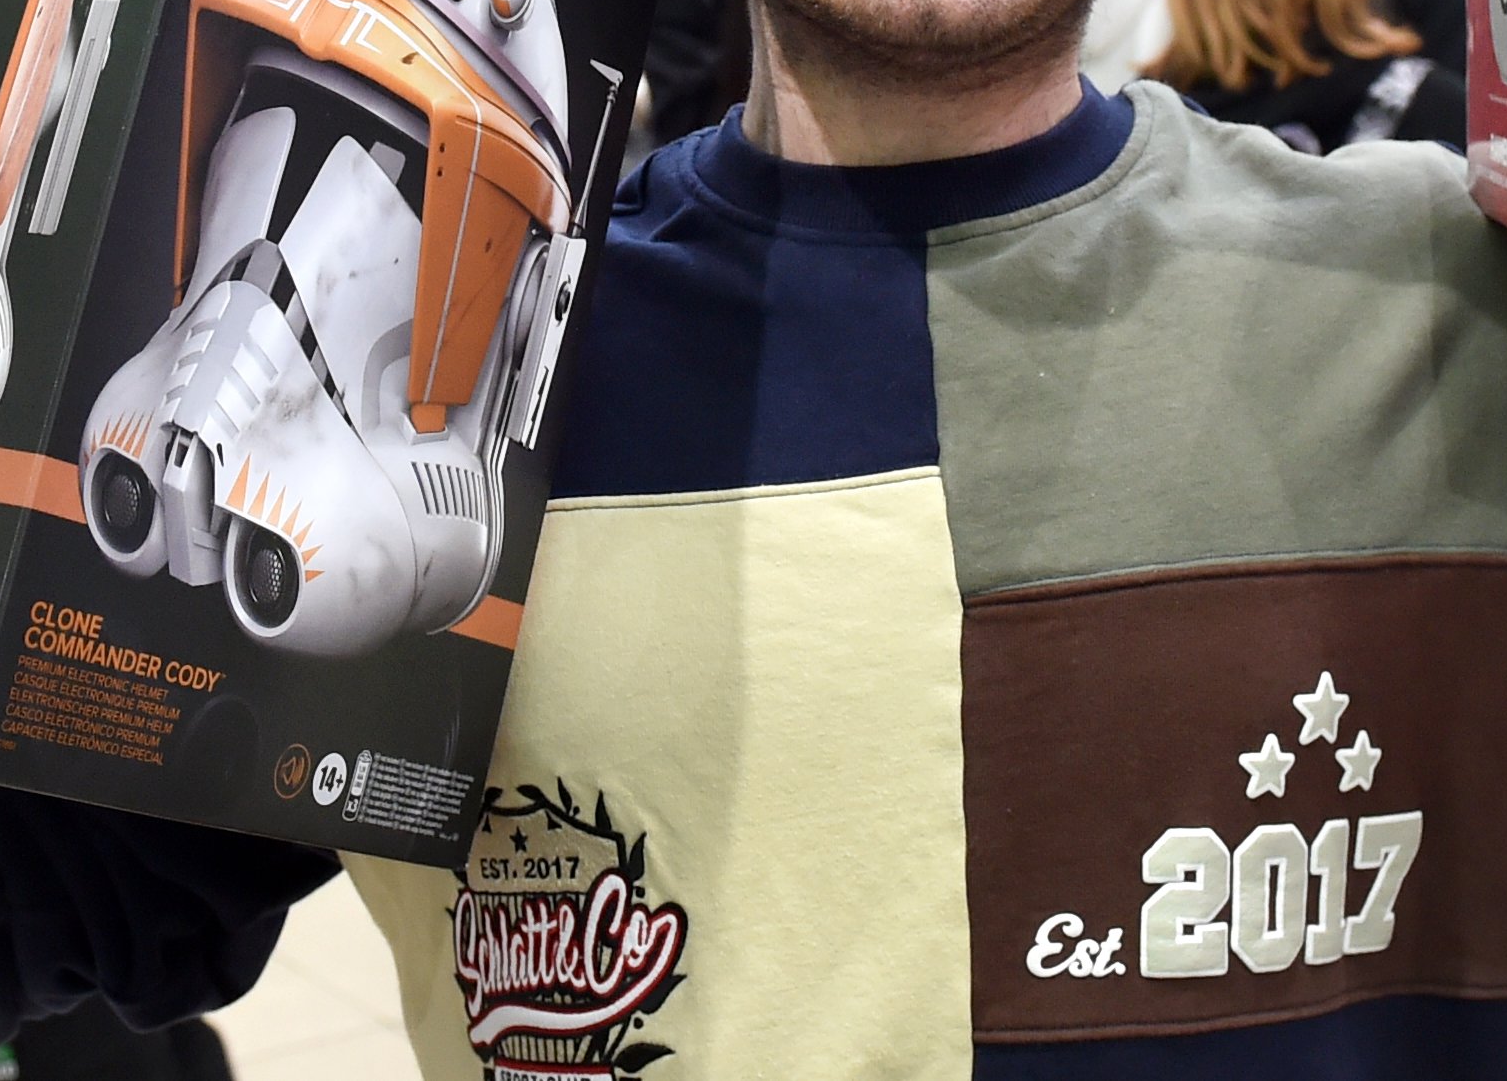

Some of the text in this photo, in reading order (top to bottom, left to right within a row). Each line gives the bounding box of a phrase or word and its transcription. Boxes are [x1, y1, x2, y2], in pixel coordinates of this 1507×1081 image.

[30, 600, 104, 639] CLONE
[17, 654, 170, 702] PREMIUM ELECTRONIC HELMET
[24, 626, 221, 693] COMMANDER CODY
[9, 686, 174, 735] ELEKTRONISCHER PREMIUM HELM
[13, 672, 58, 693] CASQUE
[137, 699, 181, 720] PREMIUM
[0, 719, 55, 743] CAPACETE
[120, 743, 165, 767] ESPECIAL
[5, 703, 44, 721] CASCO
[116, 725, 161, 748] PREMIUM
[319, 764, 343, 793] 14+
[479, 856, 580, 880] EST. 2017
[1026, 810, 1423, 979] Est. 2017
